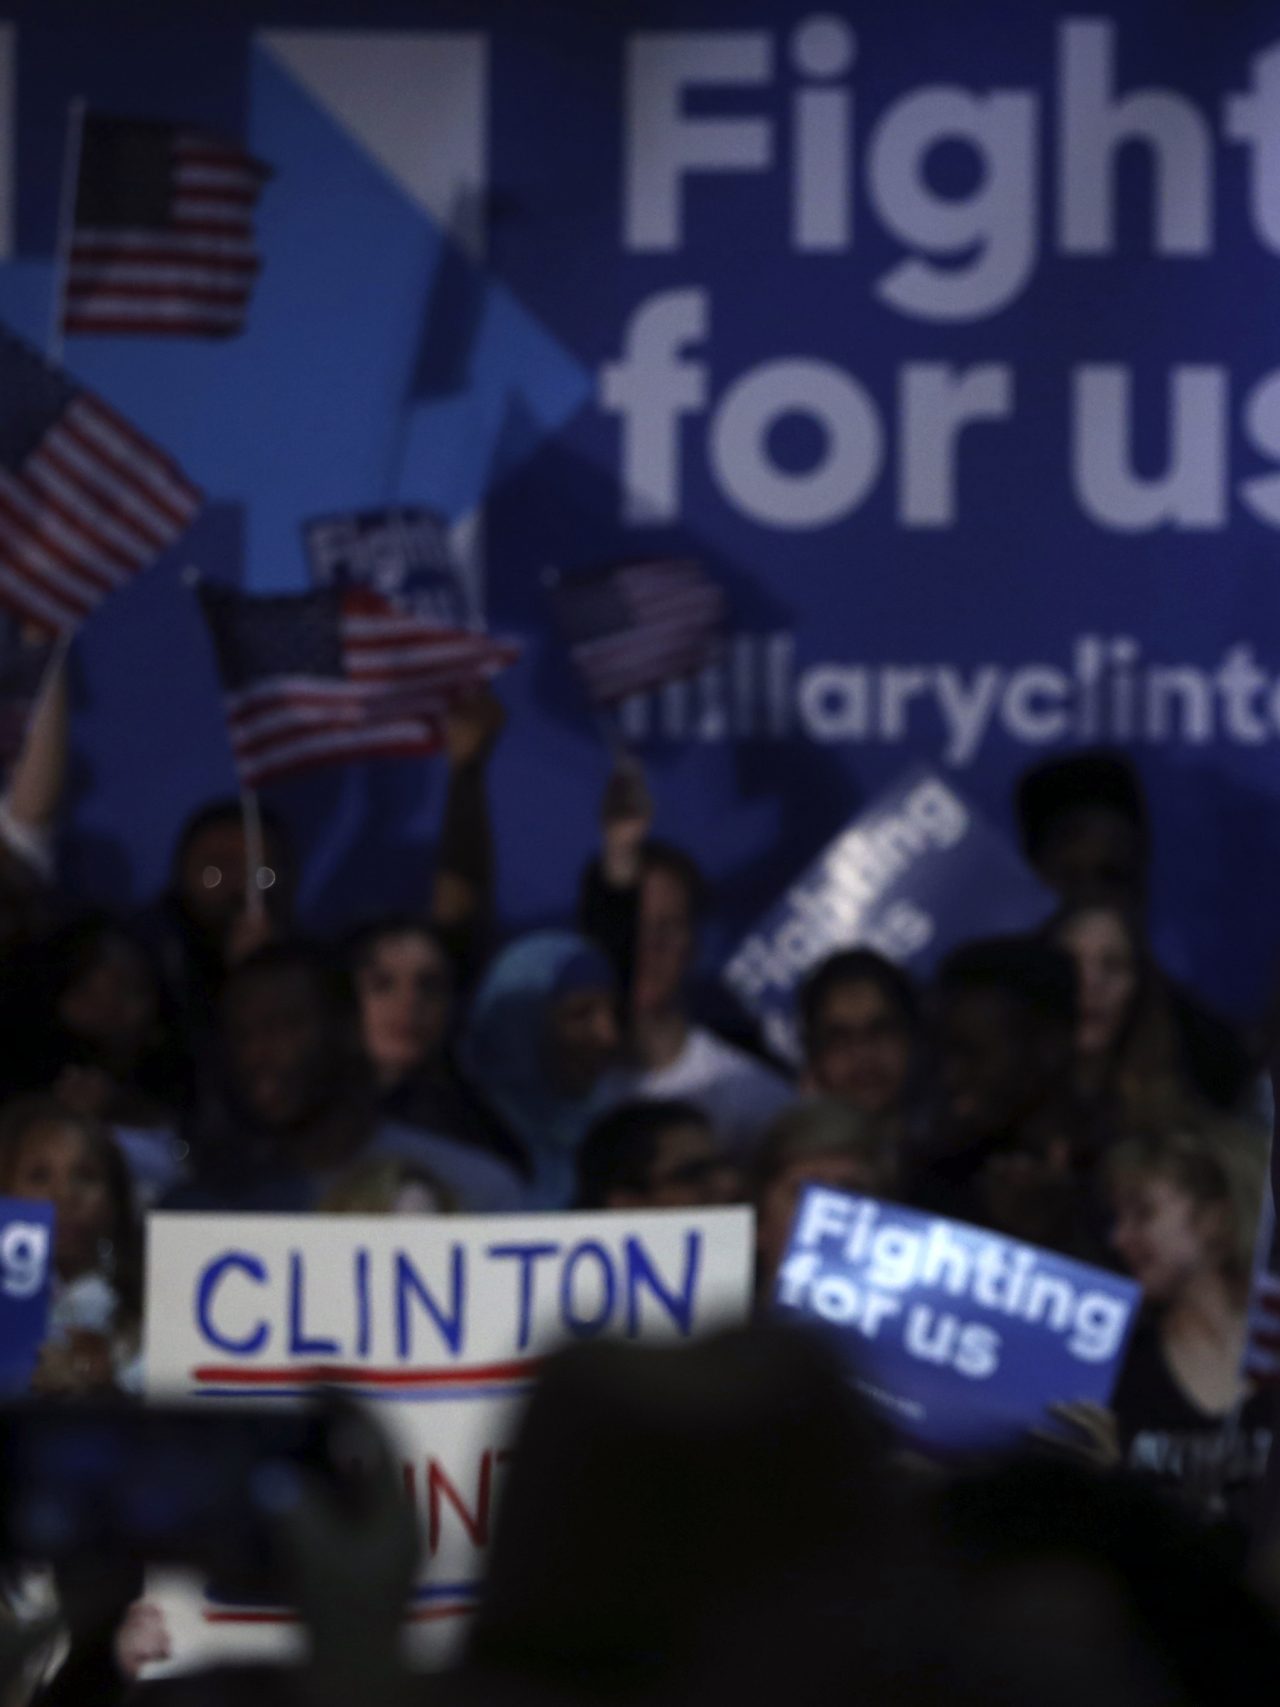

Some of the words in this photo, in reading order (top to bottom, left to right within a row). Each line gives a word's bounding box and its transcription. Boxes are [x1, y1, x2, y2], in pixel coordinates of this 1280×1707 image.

[600, 287, 1012, 530] for
[193, 1228, 702, 1359] CLINTON
[777, 1252, 898, 1339] for
[904, 1302, 1002, 1380] us
[798, 1184, 1130, 1365] Fighting
